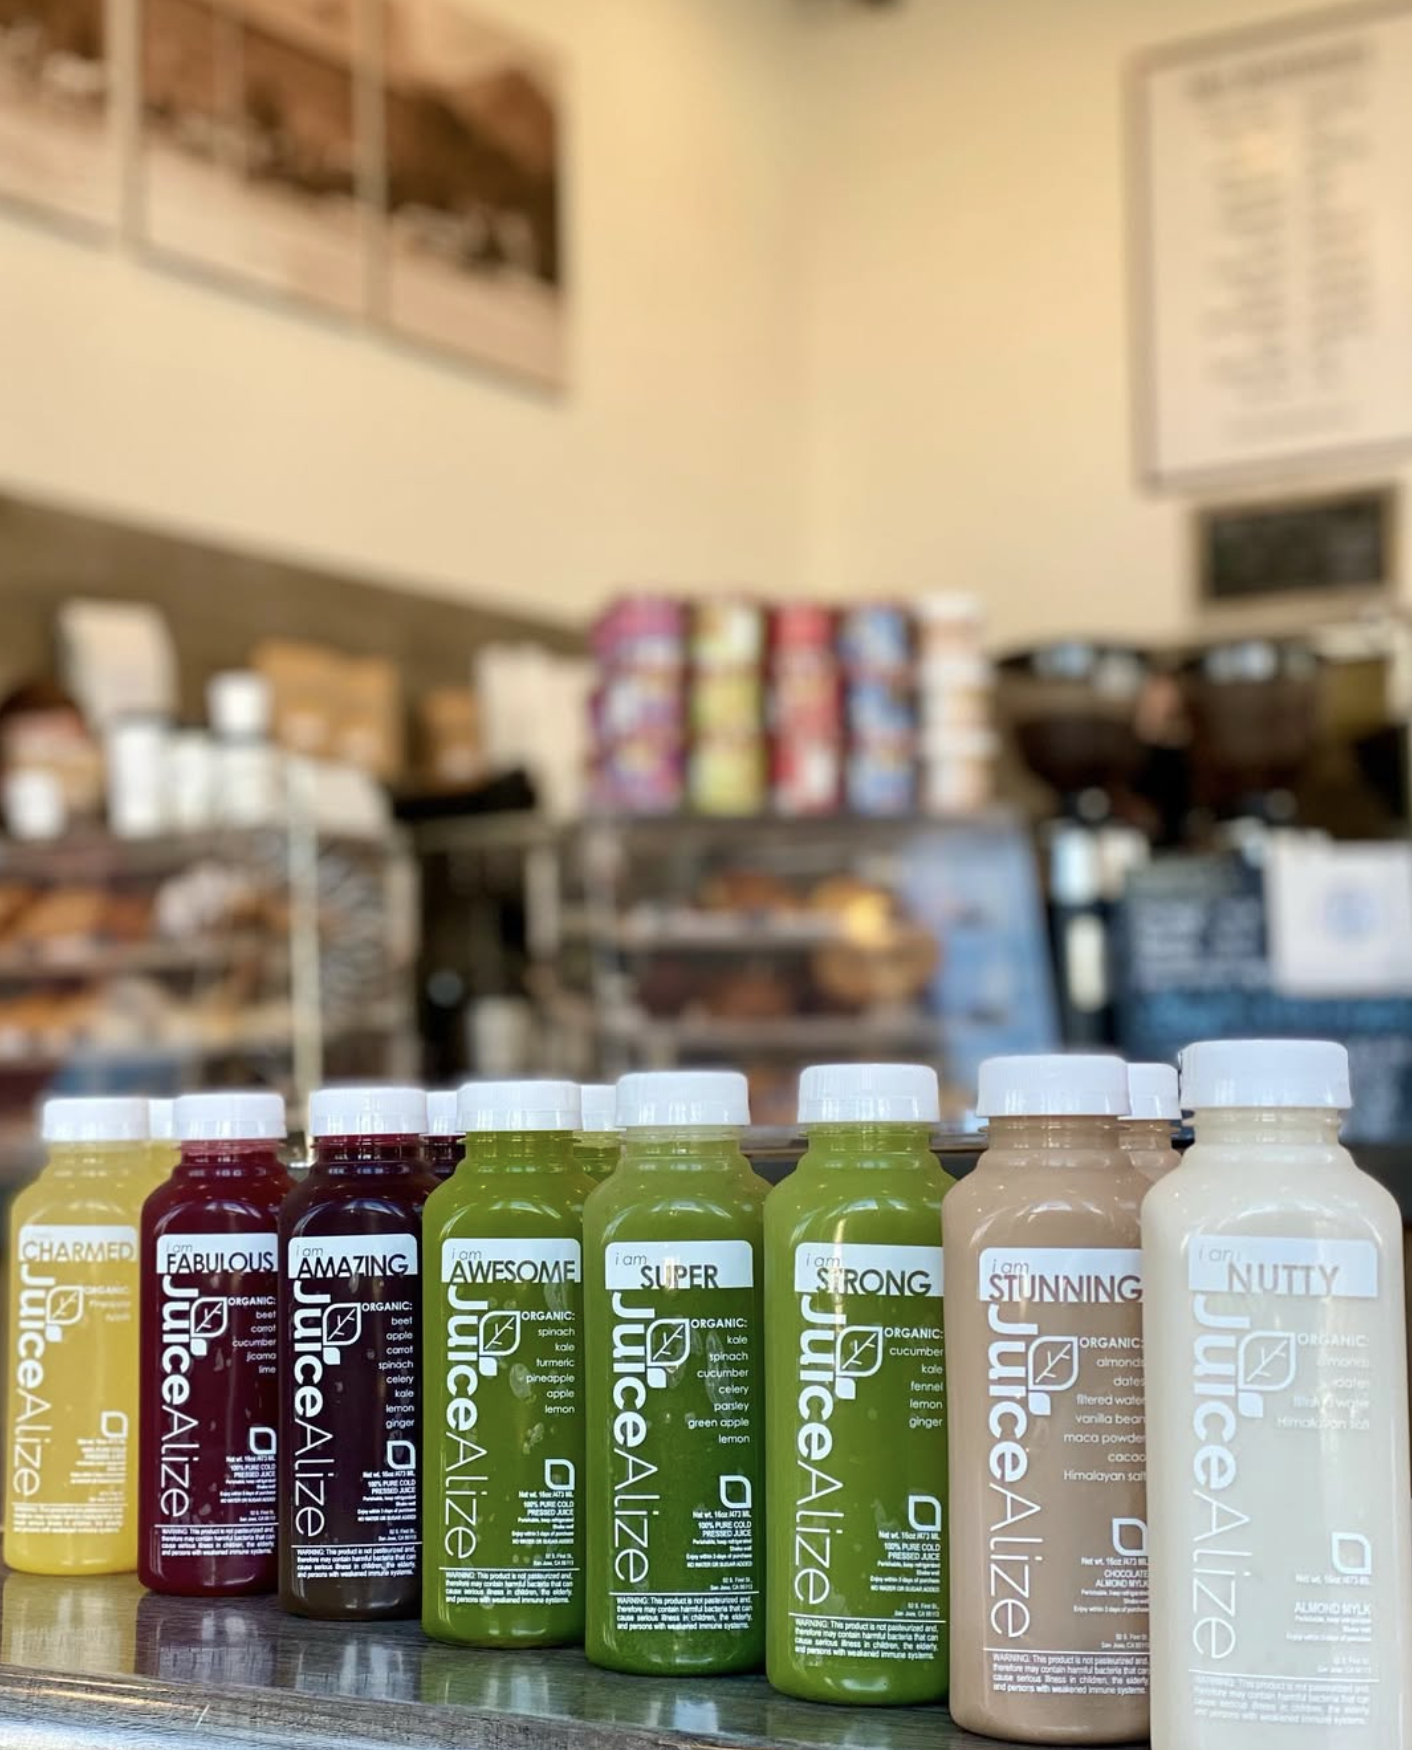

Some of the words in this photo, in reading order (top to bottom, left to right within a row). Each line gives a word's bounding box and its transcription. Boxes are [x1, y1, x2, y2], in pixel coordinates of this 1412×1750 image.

[22, 1241, 134, 1261] CHARMED
[302, 1247, 323, 1256] am
[459, 1251, 482, 1260] am
[167, 1252, 273, 1273] FABULOUS
[624, 1255, 647, 1265] am
[815, 1257, 840, 1267] am
[297, 1254, 408, 1278] AMAZING
[1001, 1262, 1029, 1273] am
[450, 1260, 575, 1284] AWESOME
[640, 1265, 718, 1288] SUPER
[816, 1268, 931, 1296] STRONG
[1227, 1262, 1339, 1297] NUTTY
[989, 1274, 1143, 1302] STUNNING
[228, 1297, 276, 1305] ORGANIC:
[362, 1302, 412, 1311] ORGANIC:
[392, 1317, 412, 1325] beet
[522, 1312, 575, 1321] ORGANIC:
[691, 1319, 747, 1328] ORGANIC:
[386, 1332, 413, 1341] apple
[538, 1327, 575, 1337] spinach
[884, 1328, 943, 1339] ORGANIC:
[727, 1335, 747, 1344] kale
[386, 1346, 413, 1354] carrot
[555, 1343, 575, 1351] kale
[247, 1353, 276, 1362] jicama
[709, 1352, 748, 1362] spinach
[889, 1348, 943, 1357] cucumber
[379, 1361, 413, 1370] spinach
[537, 1358, 574, 1367] turmeric
[258, 1366, 276, 1374] lime
[697, 1368, 748, 1378] cucumber
[922, 1364, 943, 1373] kale
[386, 1375, 414, 1385] celery
[526, 1374, 575, 1384] pineapple
[718, 1385, 749, 1395] celery
[911, 1381, 943, 1391] fennel
[395, 1389, 414, 1398] kale
[547, 1389, 575, 1399] apple
[386, 1404, 414, 1413] lemon
[714, 1402, 749, 1412] parsley
[910, 1399, 942, 1409] lemon
[545, 1405, 575, 1414] lemon
[688, 1419, 717, 1429] green
[721, 1418, 749, 1428] apple
[909, 1418, 942, 1428] ginger
[1076, 1413, 1112, 1424] vanilla
[386, 1419, 415, 1429] ginger
[719, 1434, 750, 1443] lemon
[1064, 1434, 1098, 1443] maca
[1064, 1470, 1125, 1482] Himalayan
